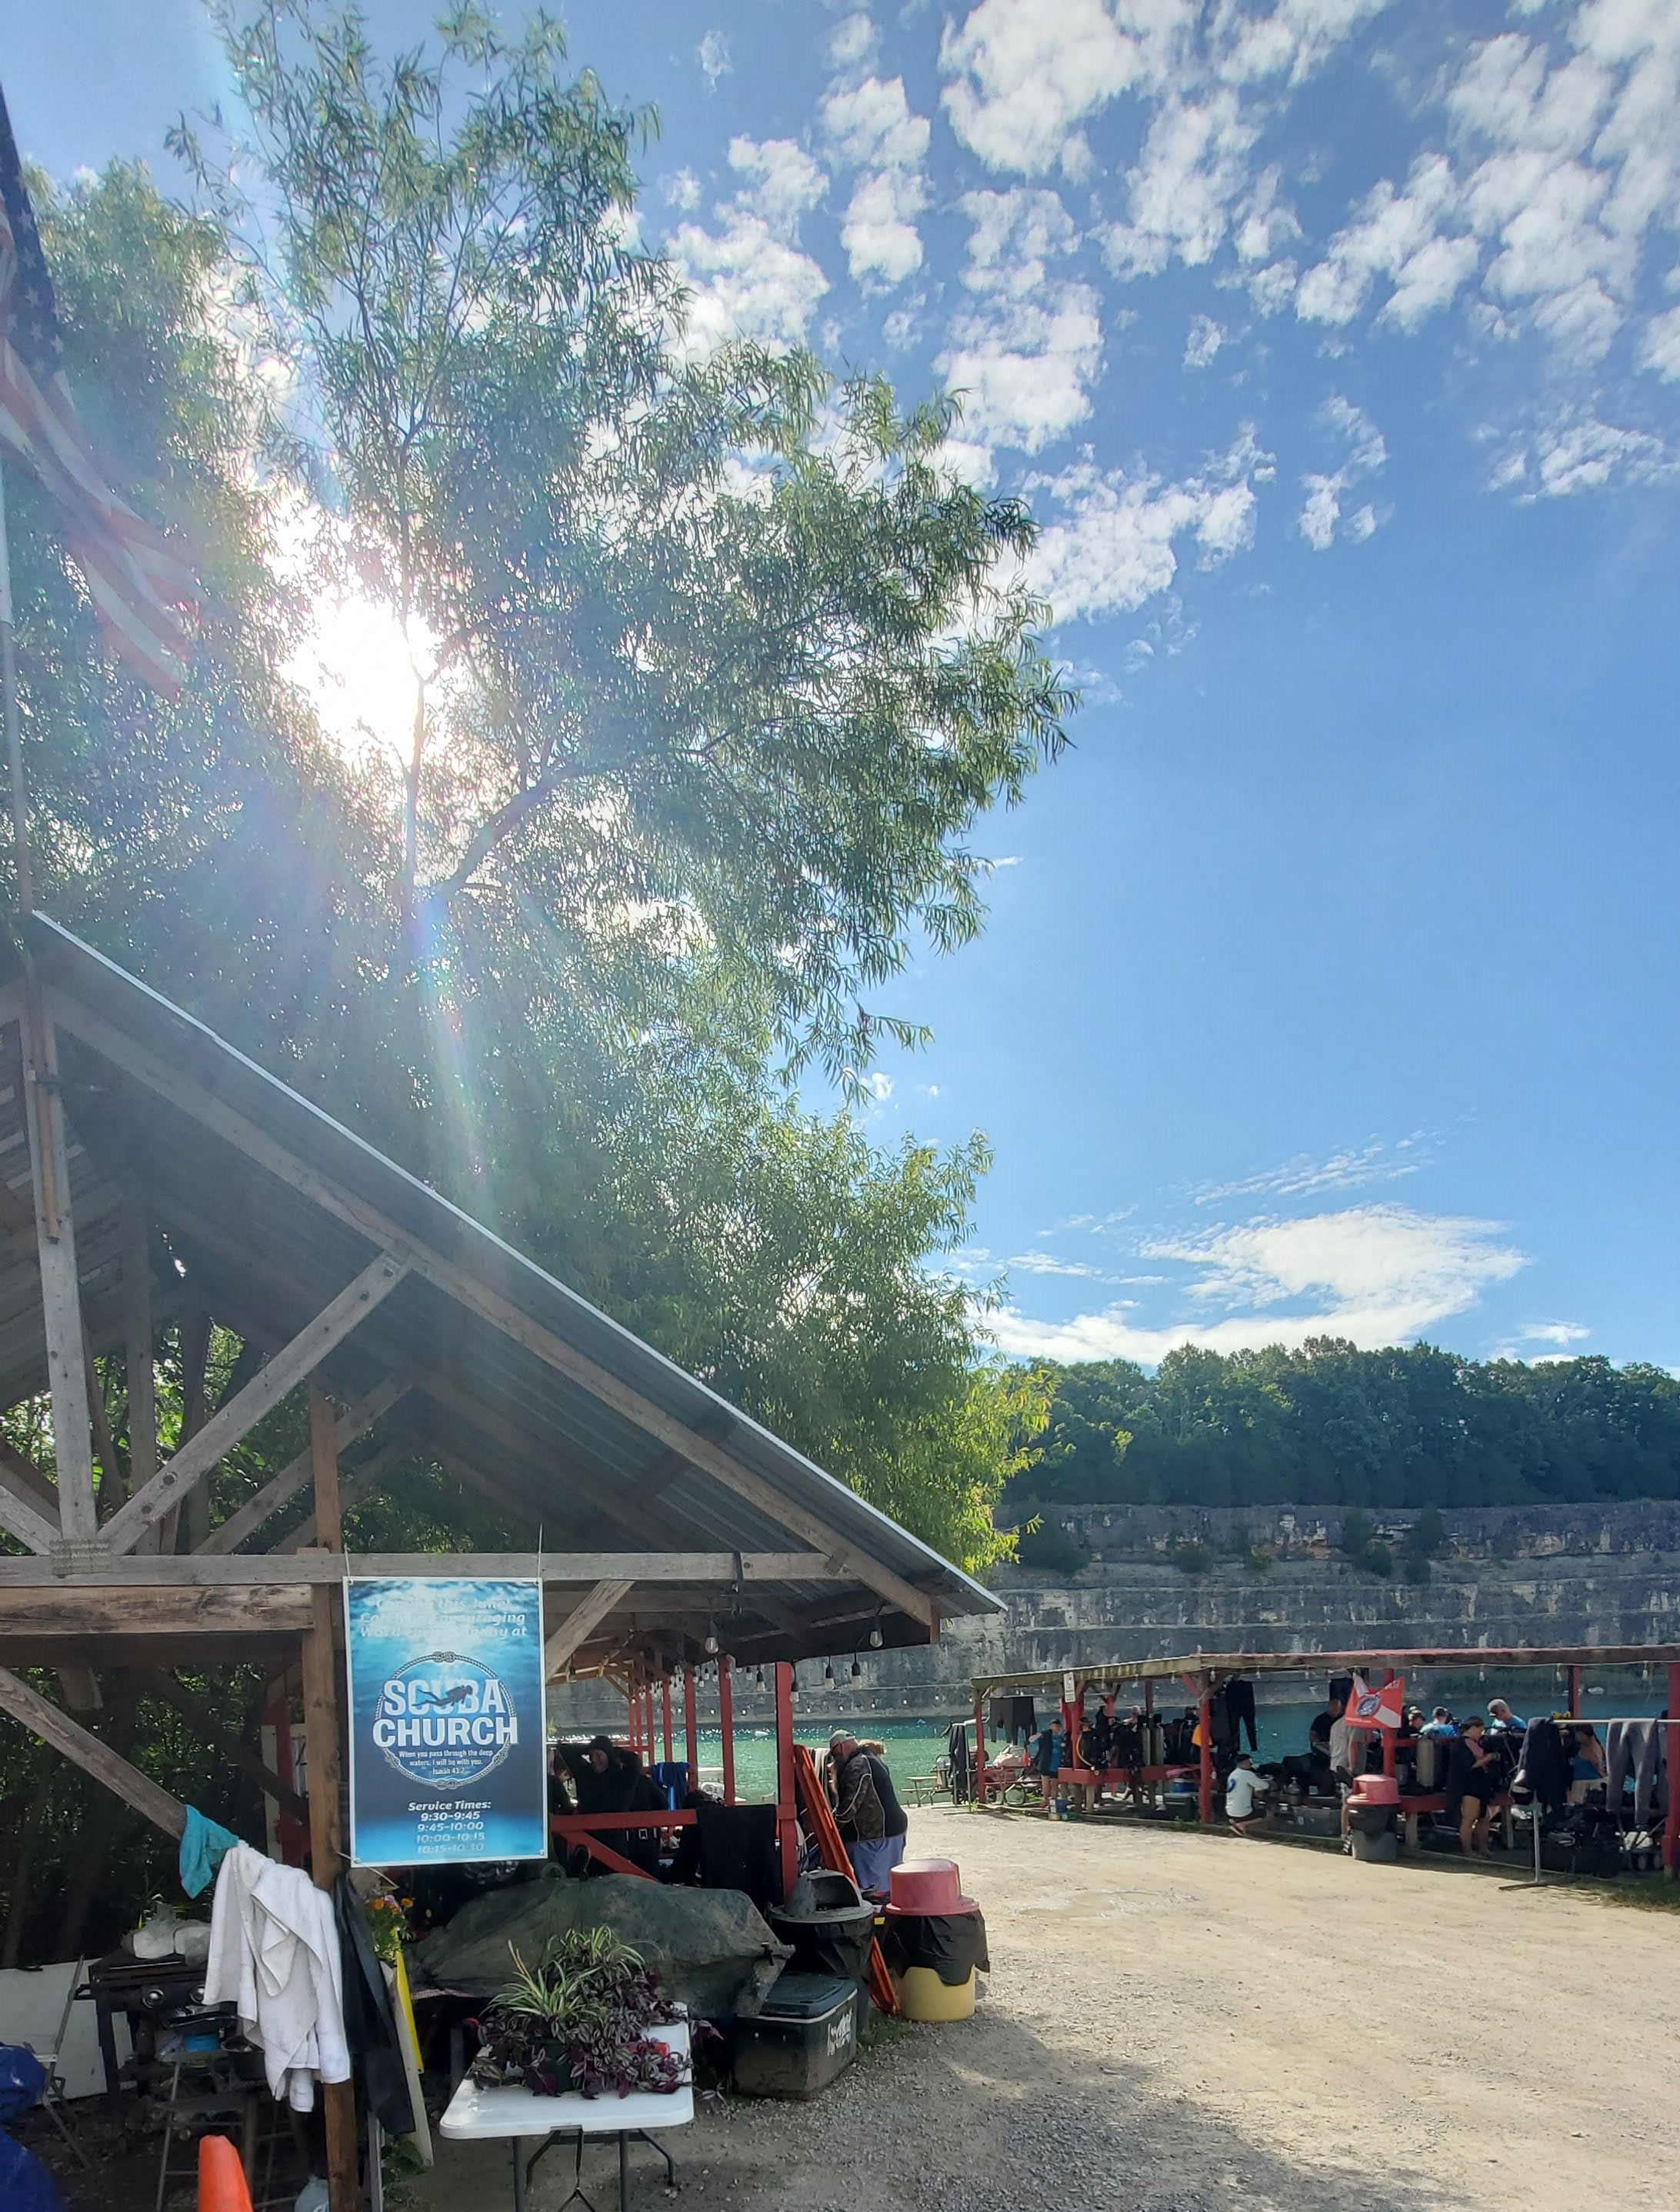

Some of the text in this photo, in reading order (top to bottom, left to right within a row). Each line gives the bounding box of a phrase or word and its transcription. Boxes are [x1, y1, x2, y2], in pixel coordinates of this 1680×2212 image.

[512, 1626, 527, 1637] at
[384, 1679, 506, 1716] SCUBA
[372, 1717, 518, 1747] CHURCH
[444, 1750, 466, 1758] through
[408, 1800, 492, 1811] Service Times:
[421, 1811, 481, 1821] 9:30-9:45
[417, 1821, 484, 1832] 9:45-10:00
[416, 1832, 485, 1843] 10:00-10:15
